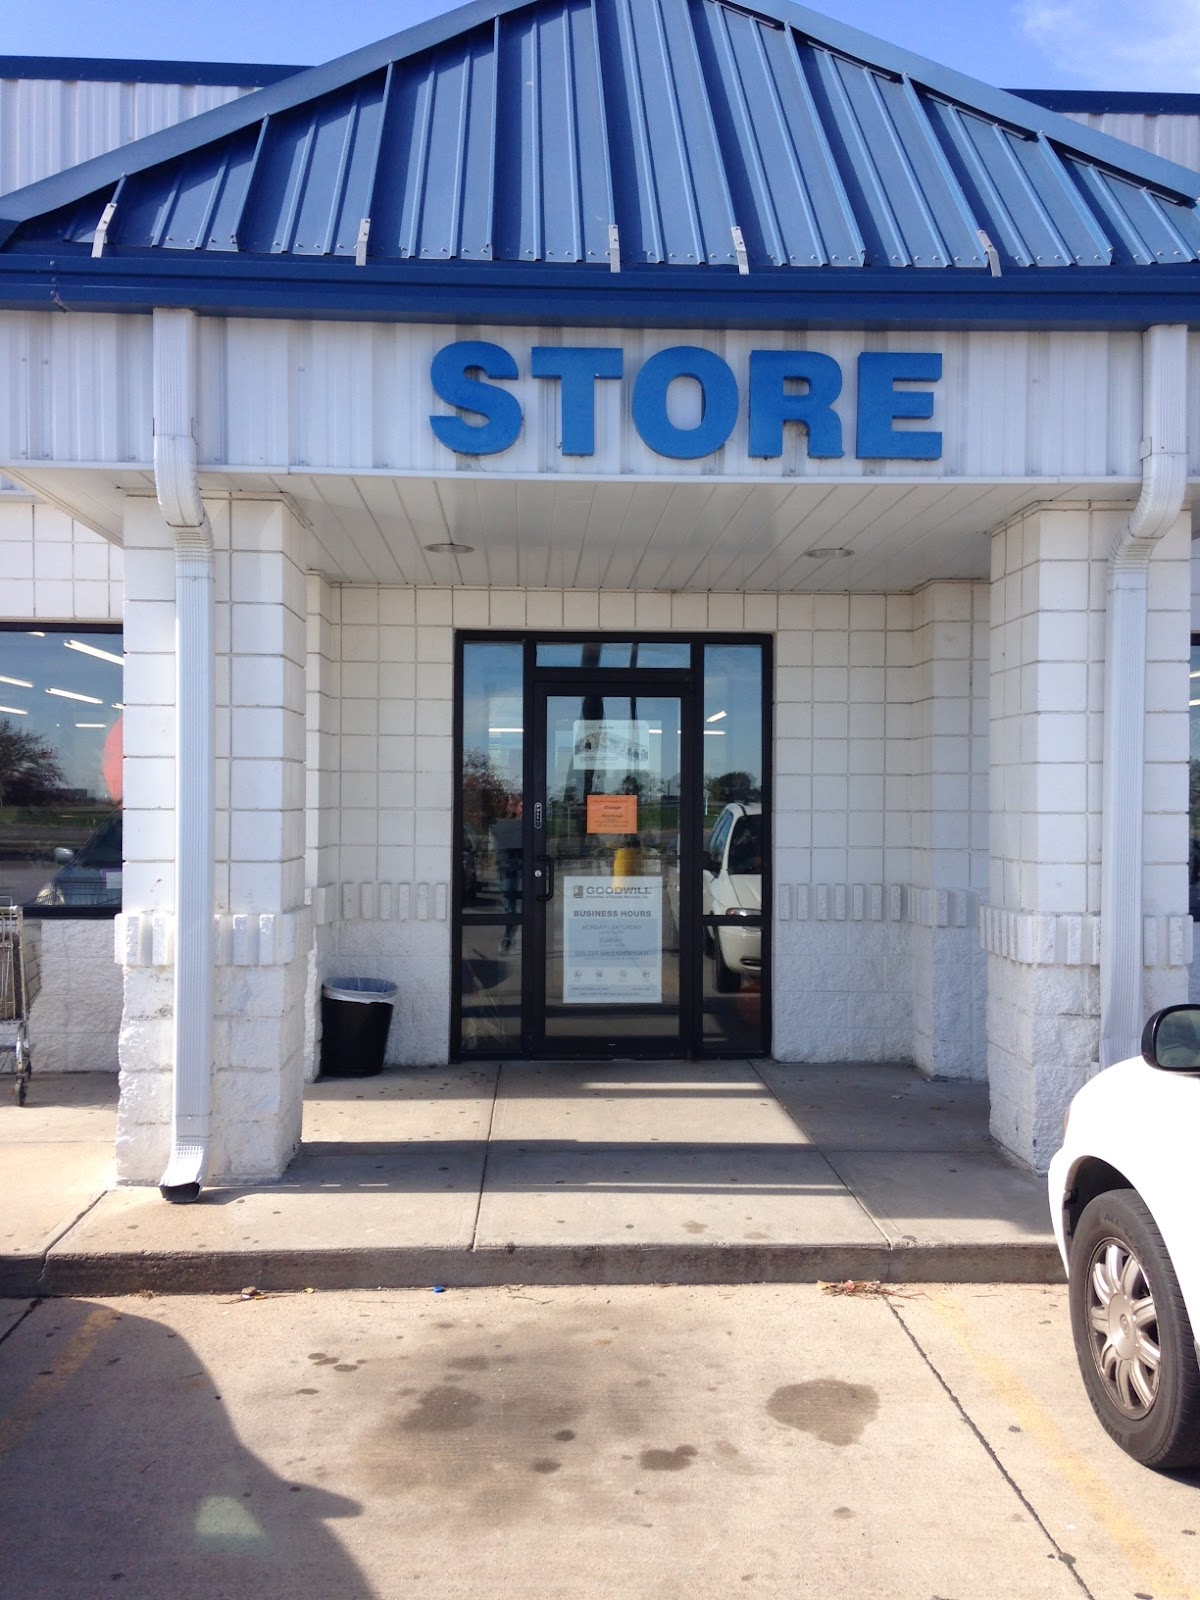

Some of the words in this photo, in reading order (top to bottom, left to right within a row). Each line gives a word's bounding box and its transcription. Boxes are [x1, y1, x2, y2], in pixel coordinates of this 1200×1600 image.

[429, 340, 943, 461] STORE
[586, 886, 652, 895] GOODWILL
[574, 910, 618, 918] BUSINESS
[620, 910, 652, 918] HOURS
